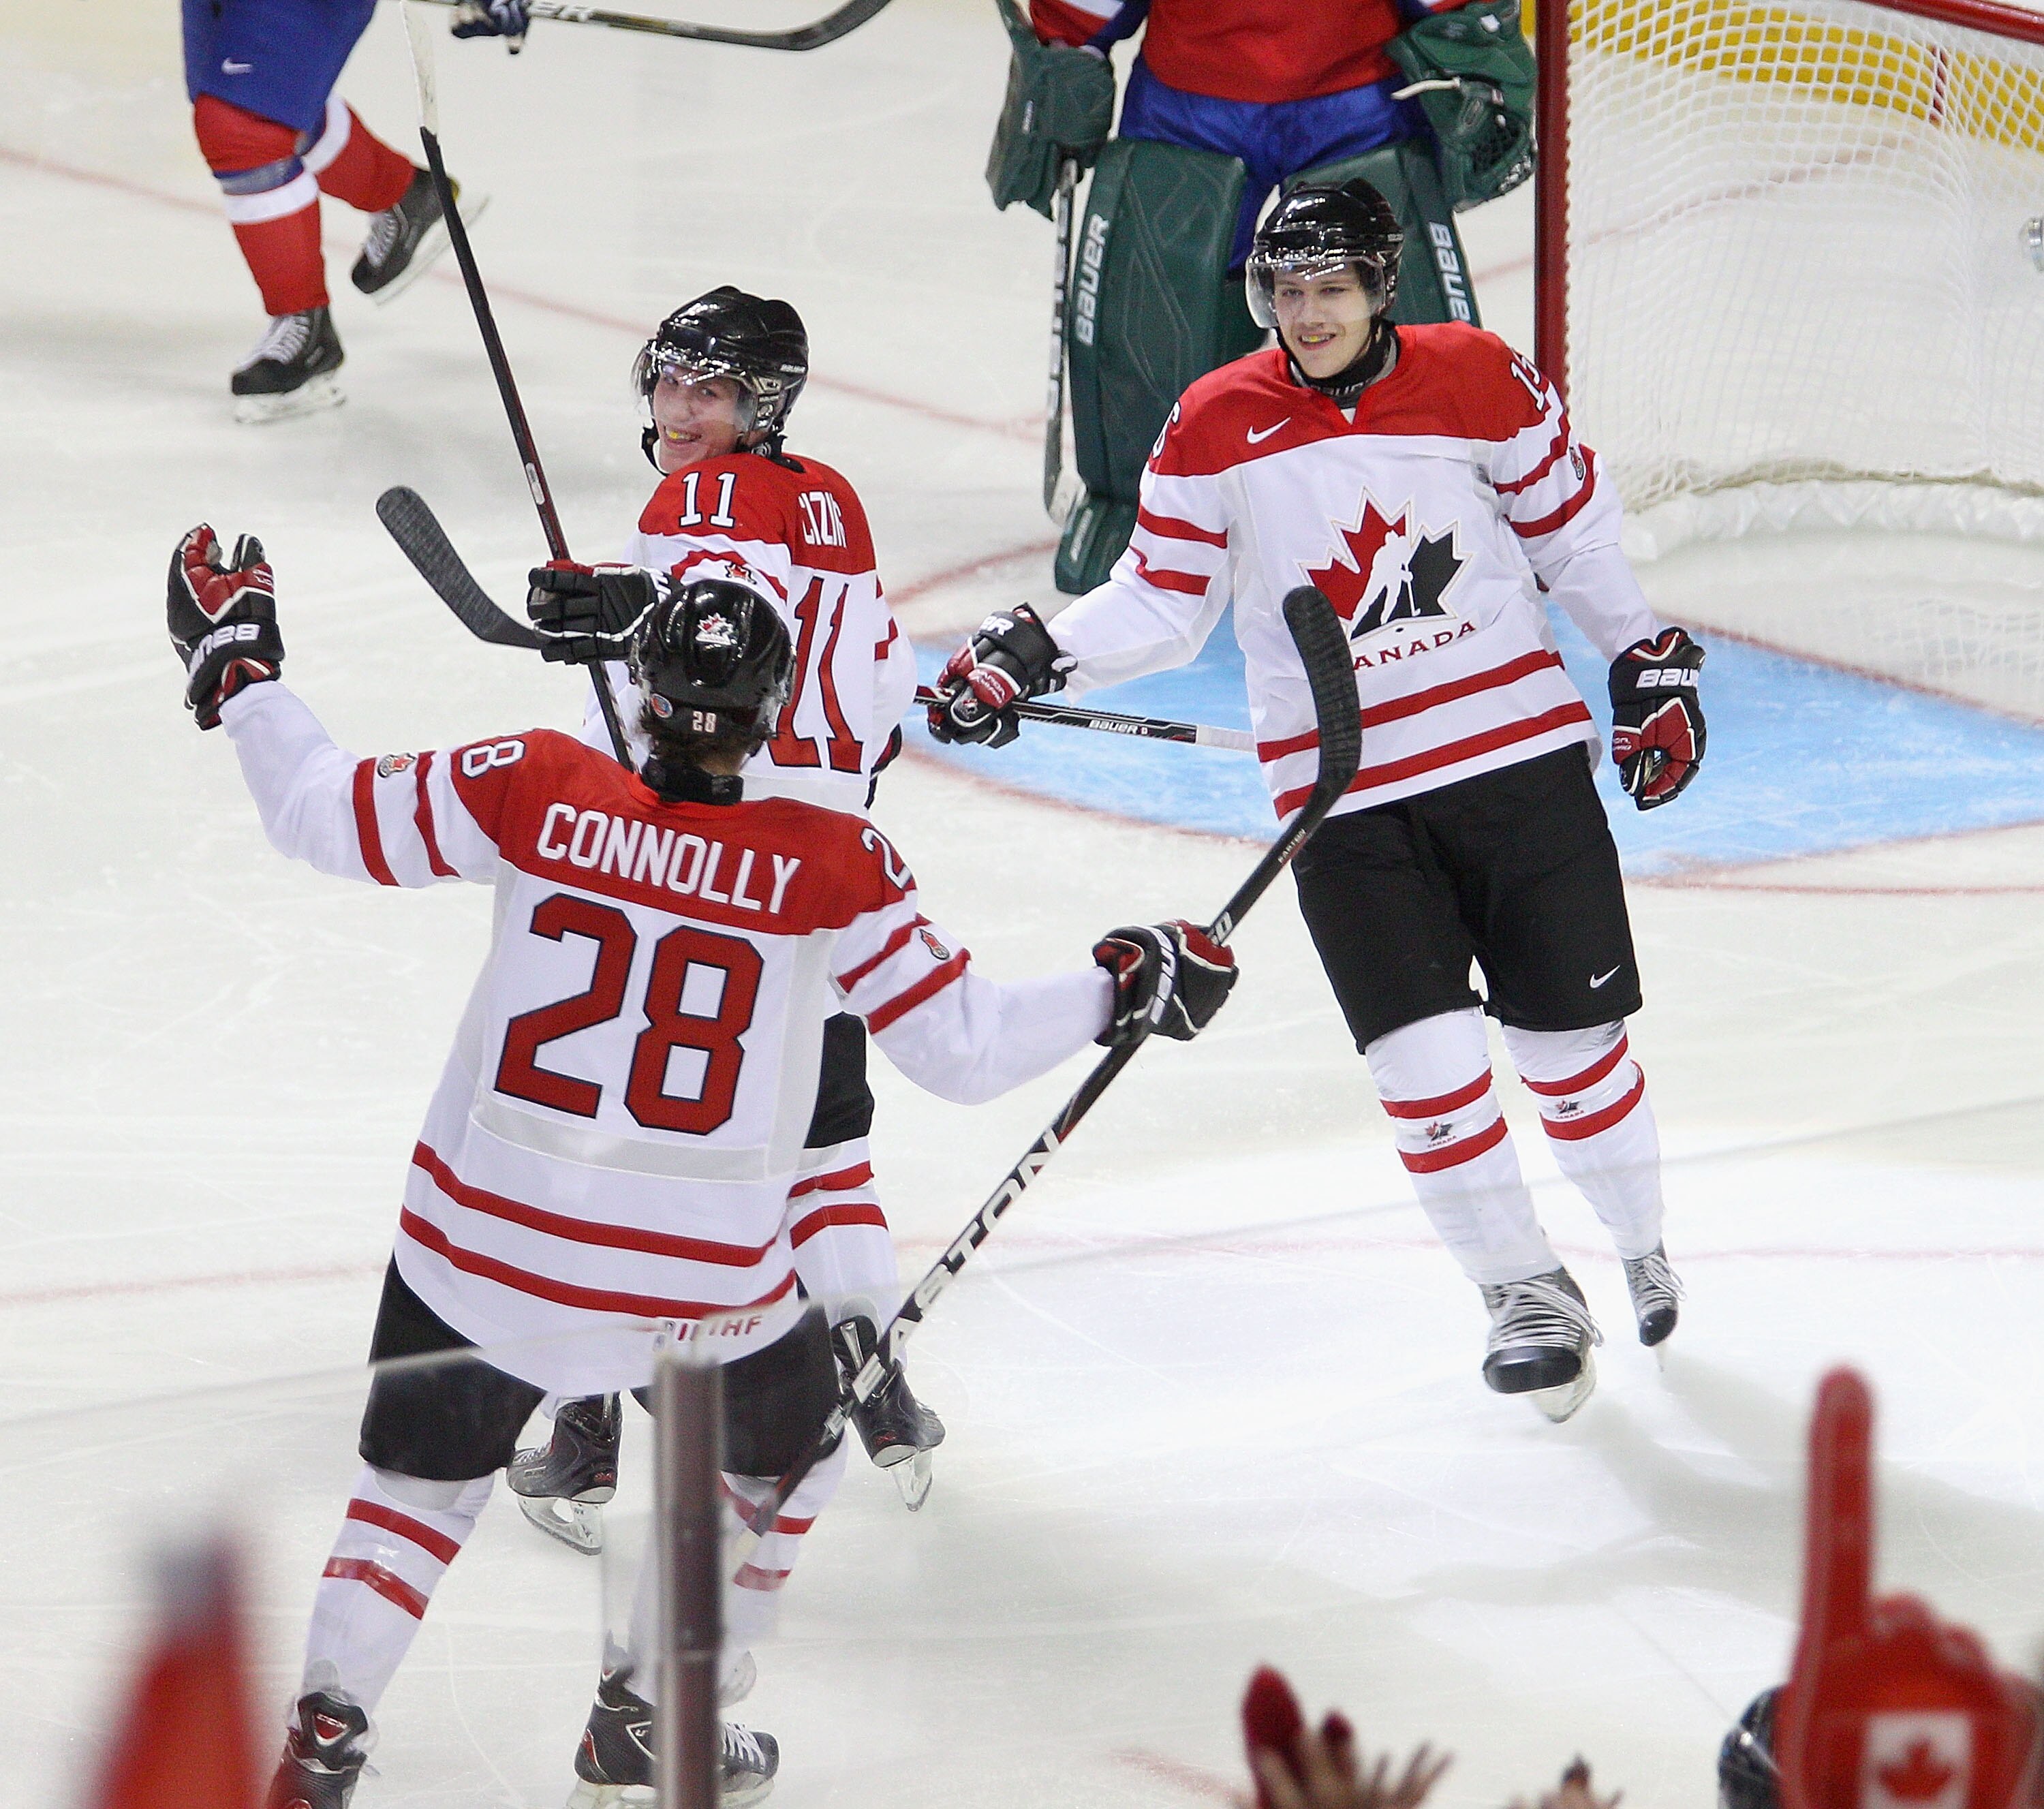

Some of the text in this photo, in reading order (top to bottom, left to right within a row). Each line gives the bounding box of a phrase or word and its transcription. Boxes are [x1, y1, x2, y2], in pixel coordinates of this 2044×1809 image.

[1074, 213, 1111, 346] BAUER
[679, 471, 737, 528] 11
[768, 576, 864, 774] 11
[1352, 621, 1476, 670] ANADA
[462, 739, 525, 778] 8
[692, 711, 716, 733] 28
[536, 803, 801, 914] CONNOLLY
[860, 826, 913, 891] 2
[494, 892, 764, 1136] 28
[852, 1127, 1061, 1404] EASTON
